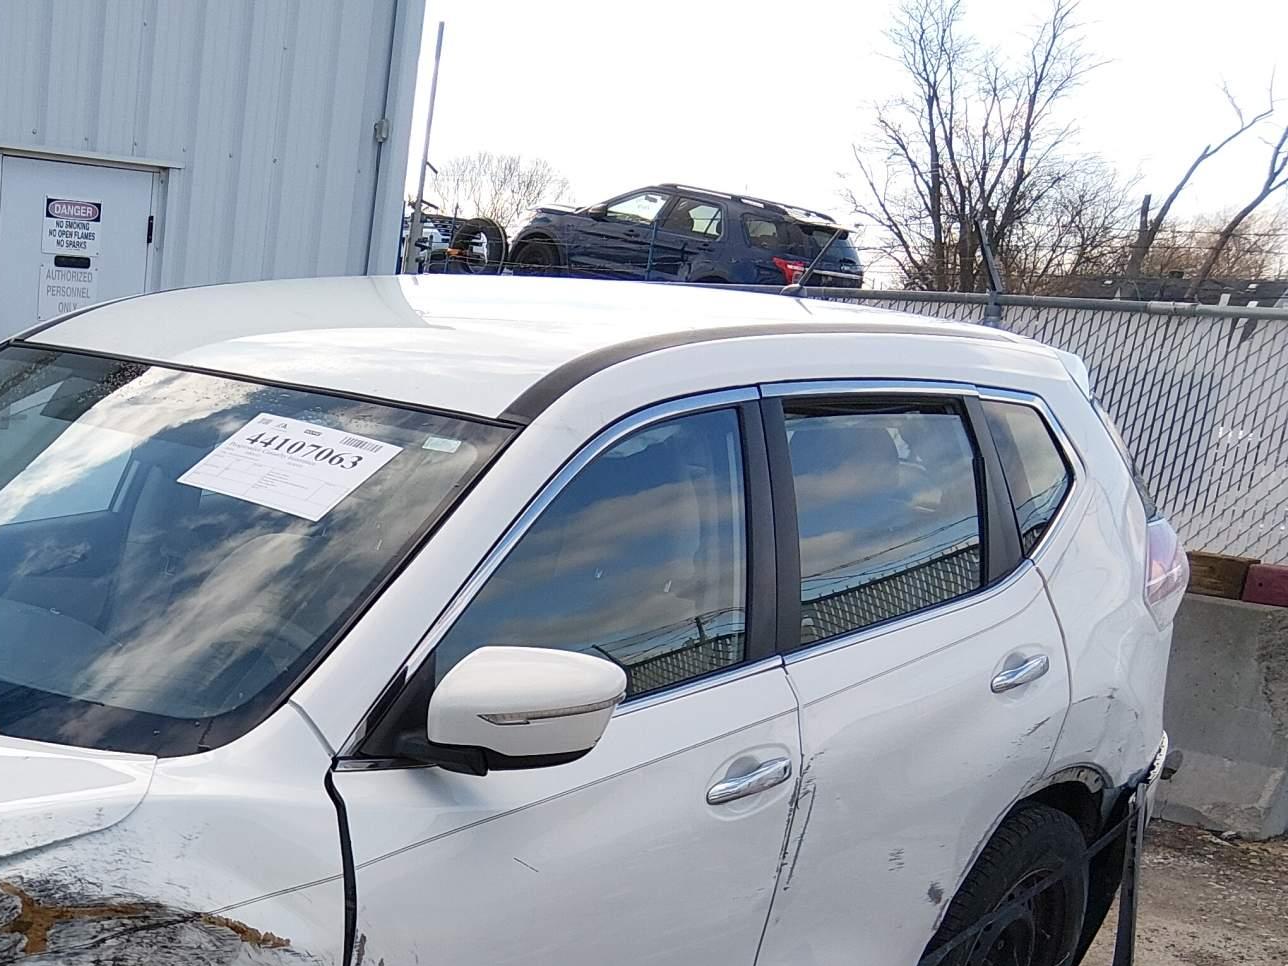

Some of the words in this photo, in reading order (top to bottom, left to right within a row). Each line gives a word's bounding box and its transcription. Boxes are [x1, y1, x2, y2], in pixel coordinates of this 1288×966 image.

[54, 204, 92, 217] DANGER
[56, 220, 64, 229] NO
[65, 221, 90, 231] SMOKING
[49, 229, 57, 238] NO
[58, 230, 73, 239] OPEN
[74, 231, 96, 241] FLAMES
[57, 239, 65, 248] NO
[66, 240, 87, 249] SPARKS
[46, 269, 93, 283] AUTHORIZED
[46, 285, 90, 299] PERSONNEL
[246, 431, 364, 470] 44107063
